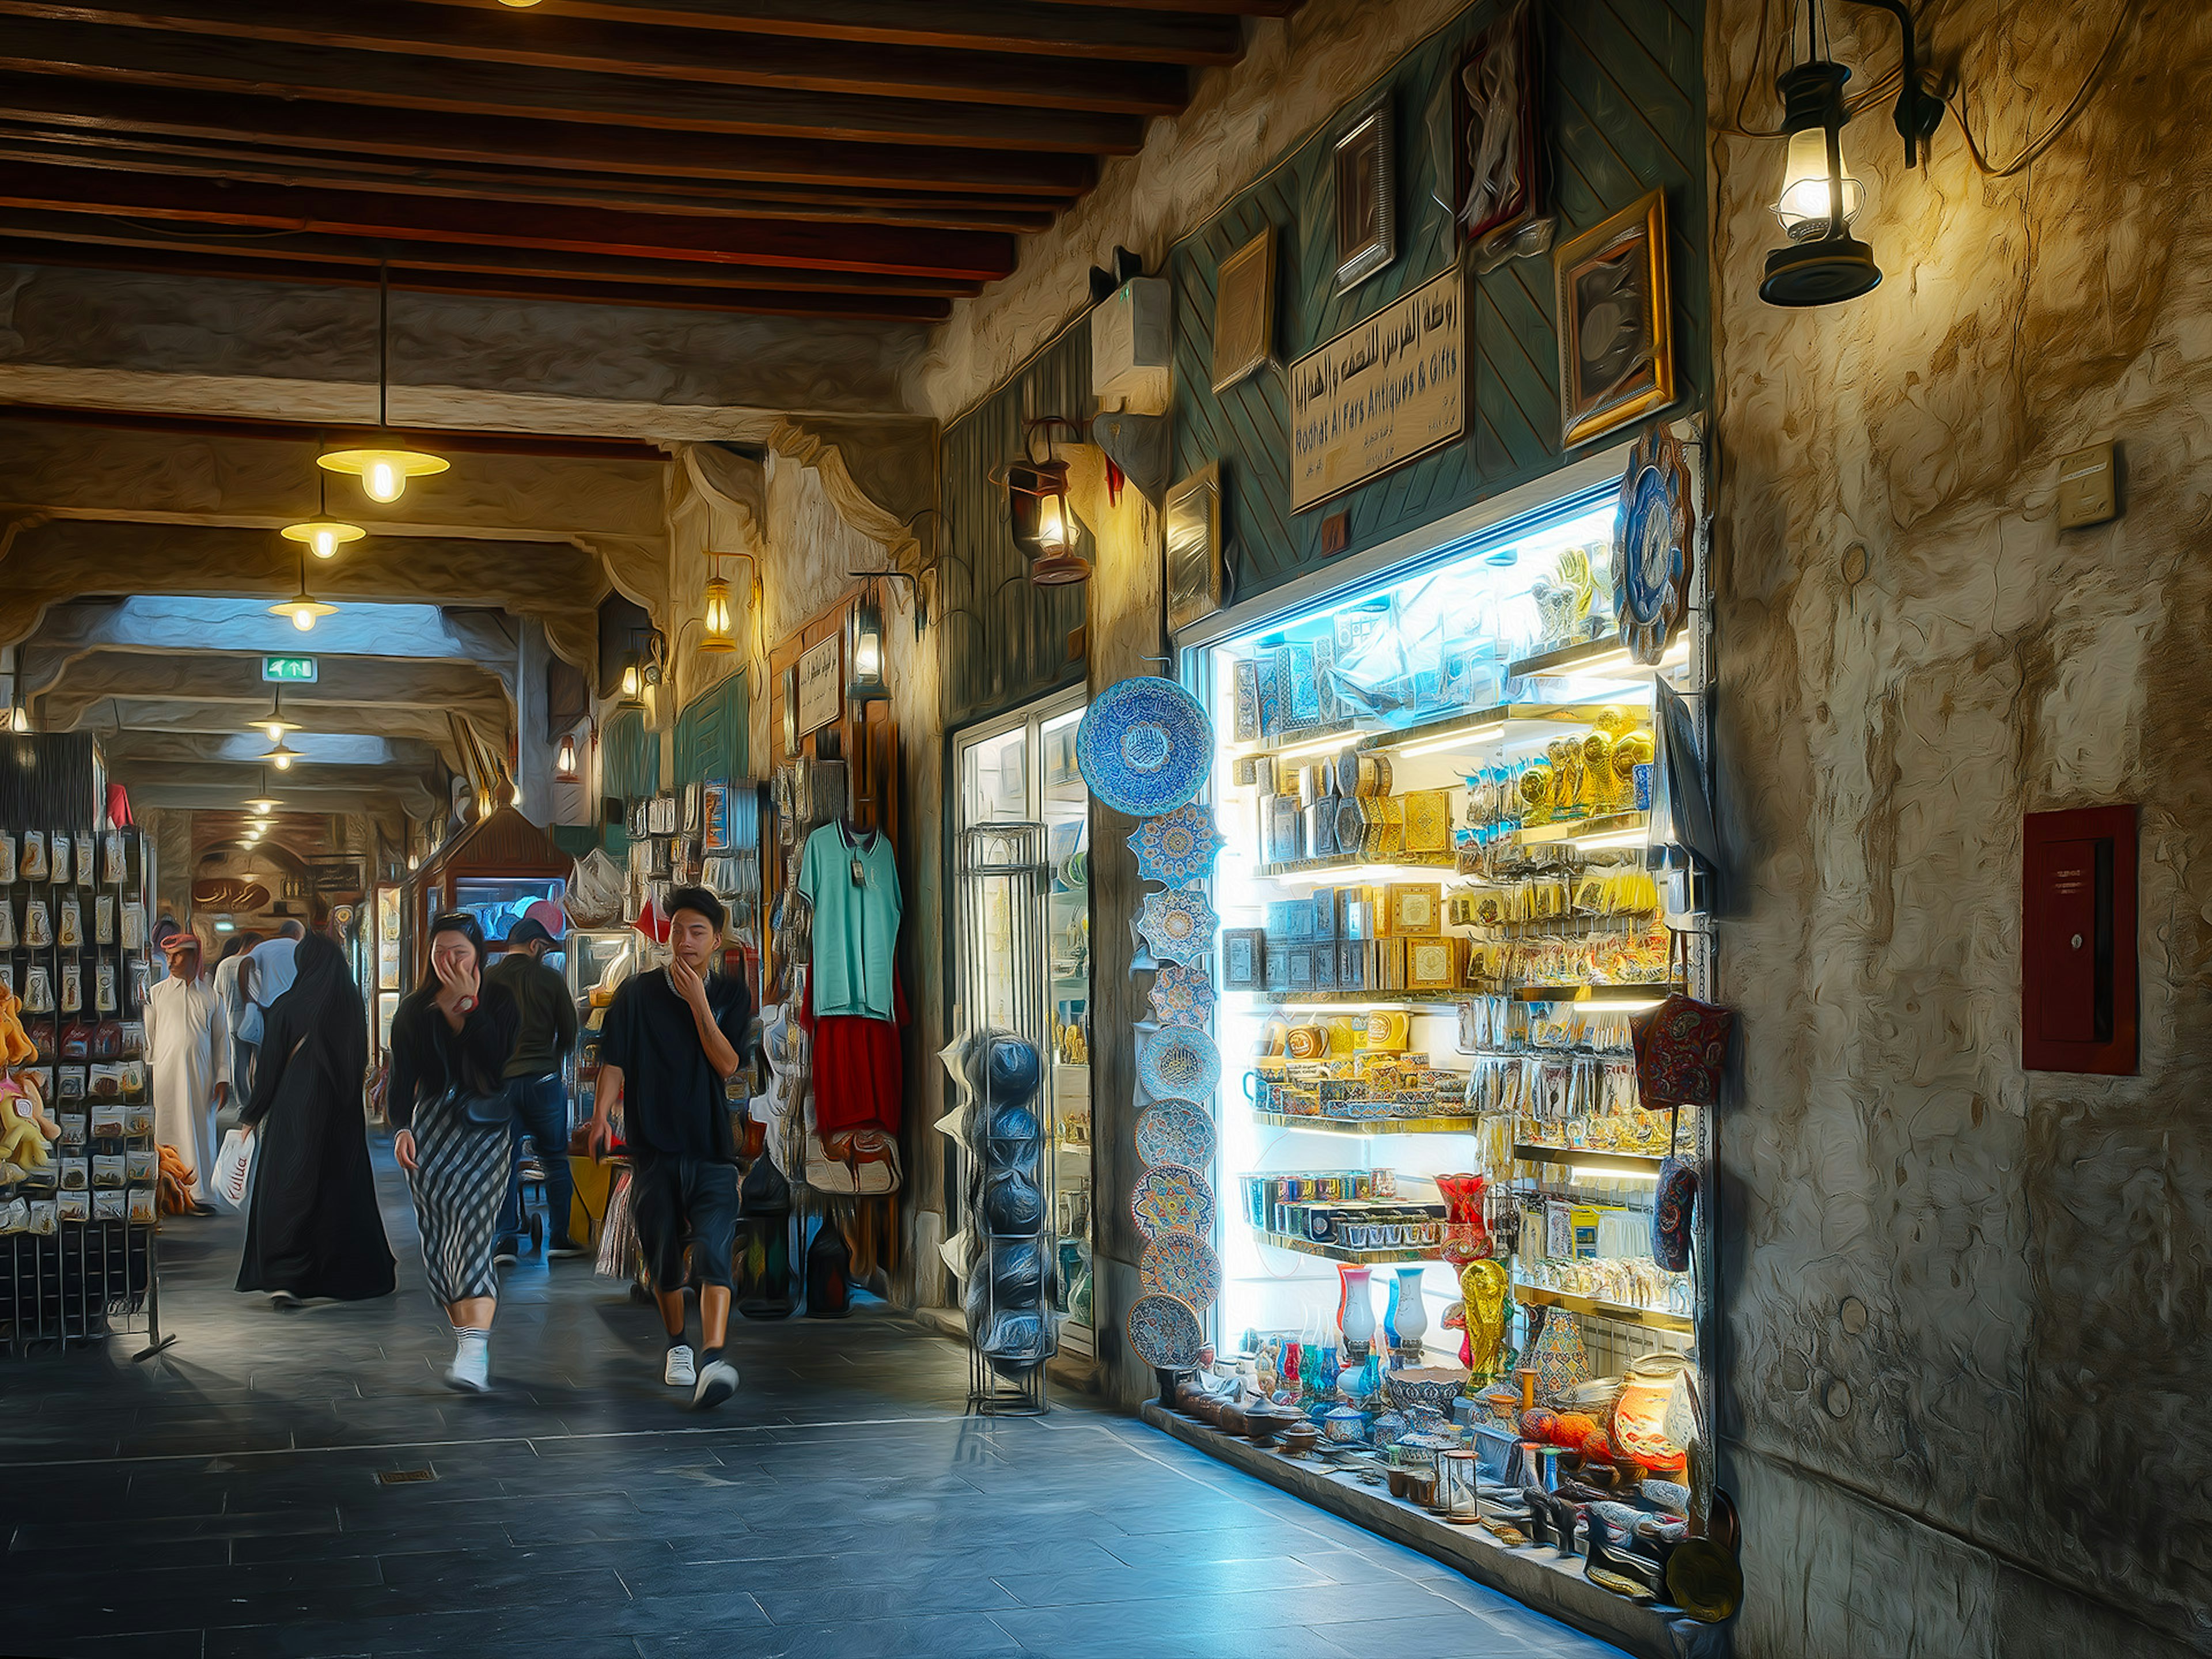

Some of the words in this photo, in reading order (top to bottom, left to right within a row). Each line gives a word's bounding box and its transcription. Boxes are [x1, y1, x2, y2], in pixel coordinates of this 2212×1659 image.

[1382, 300, 1421, 368] الفرس
[1423, 290, 1457, 333] روضة
[1342, 324, 1380, 381] للتحف
[1296, 353, 1338, 416] والهدايا
[1296, 415, 1328, 458] Rodhat
[1331, 408, 1341, 440] Al
[1343, 400, 1365, 434] Fars
[1368, 372, 1414, 419] Antiques
[1418, 361, 1426, 392] &
[1430, 347, 1457, 385] Gifts
